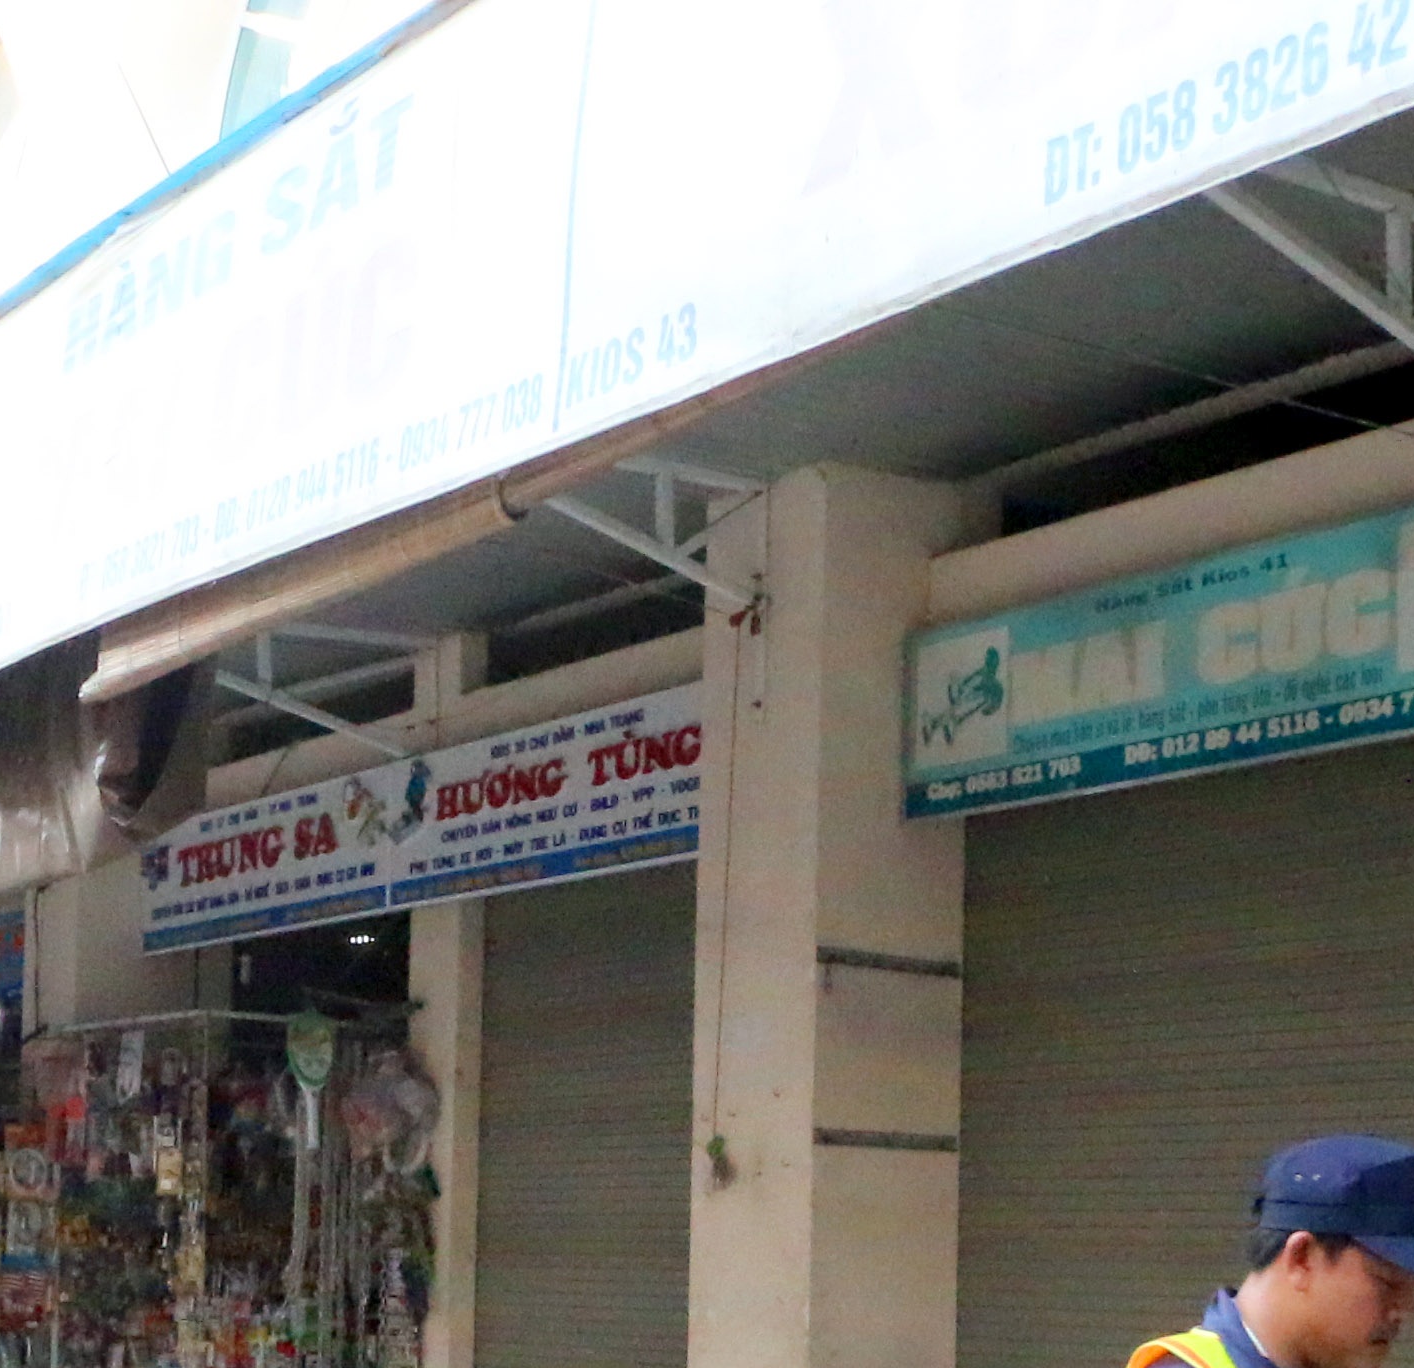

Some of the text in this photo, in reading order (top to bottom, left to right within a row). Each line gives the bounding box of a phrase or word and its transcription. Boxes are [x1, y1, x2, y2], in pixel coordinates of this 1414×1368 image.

[1043, 122, 1102, 207] ĐT:
[1117, 79, 1196, 176] 058
[1212, 22, 1330, 136] 3826
[62, 92, 415, 374] HÀNG SẮT
[565, 301, 698, 410] KIOS 43
[294, 456, 328, 512] 944
[333, 435, 381, 497] 5116
[398, 413, 449, 473] 0934
[458, 391, 498, 453] 777
[502, 372, 545, 433] 038
[1202, 565, 1250, 588] Kios
[1259, 552, 1289, 573] 41
[435, 721, 702, 822] HƯƠNG TÙNG
[1048, 756, 1082, 780] 703
[1161, 732, 1200, 759] 012
[1237, 721, 1262, 744] 44
[1267, 710, 1321, 740] 5116
[176, 825, 287, 889] TRUNG
[294, 811, 340, 861] SA
